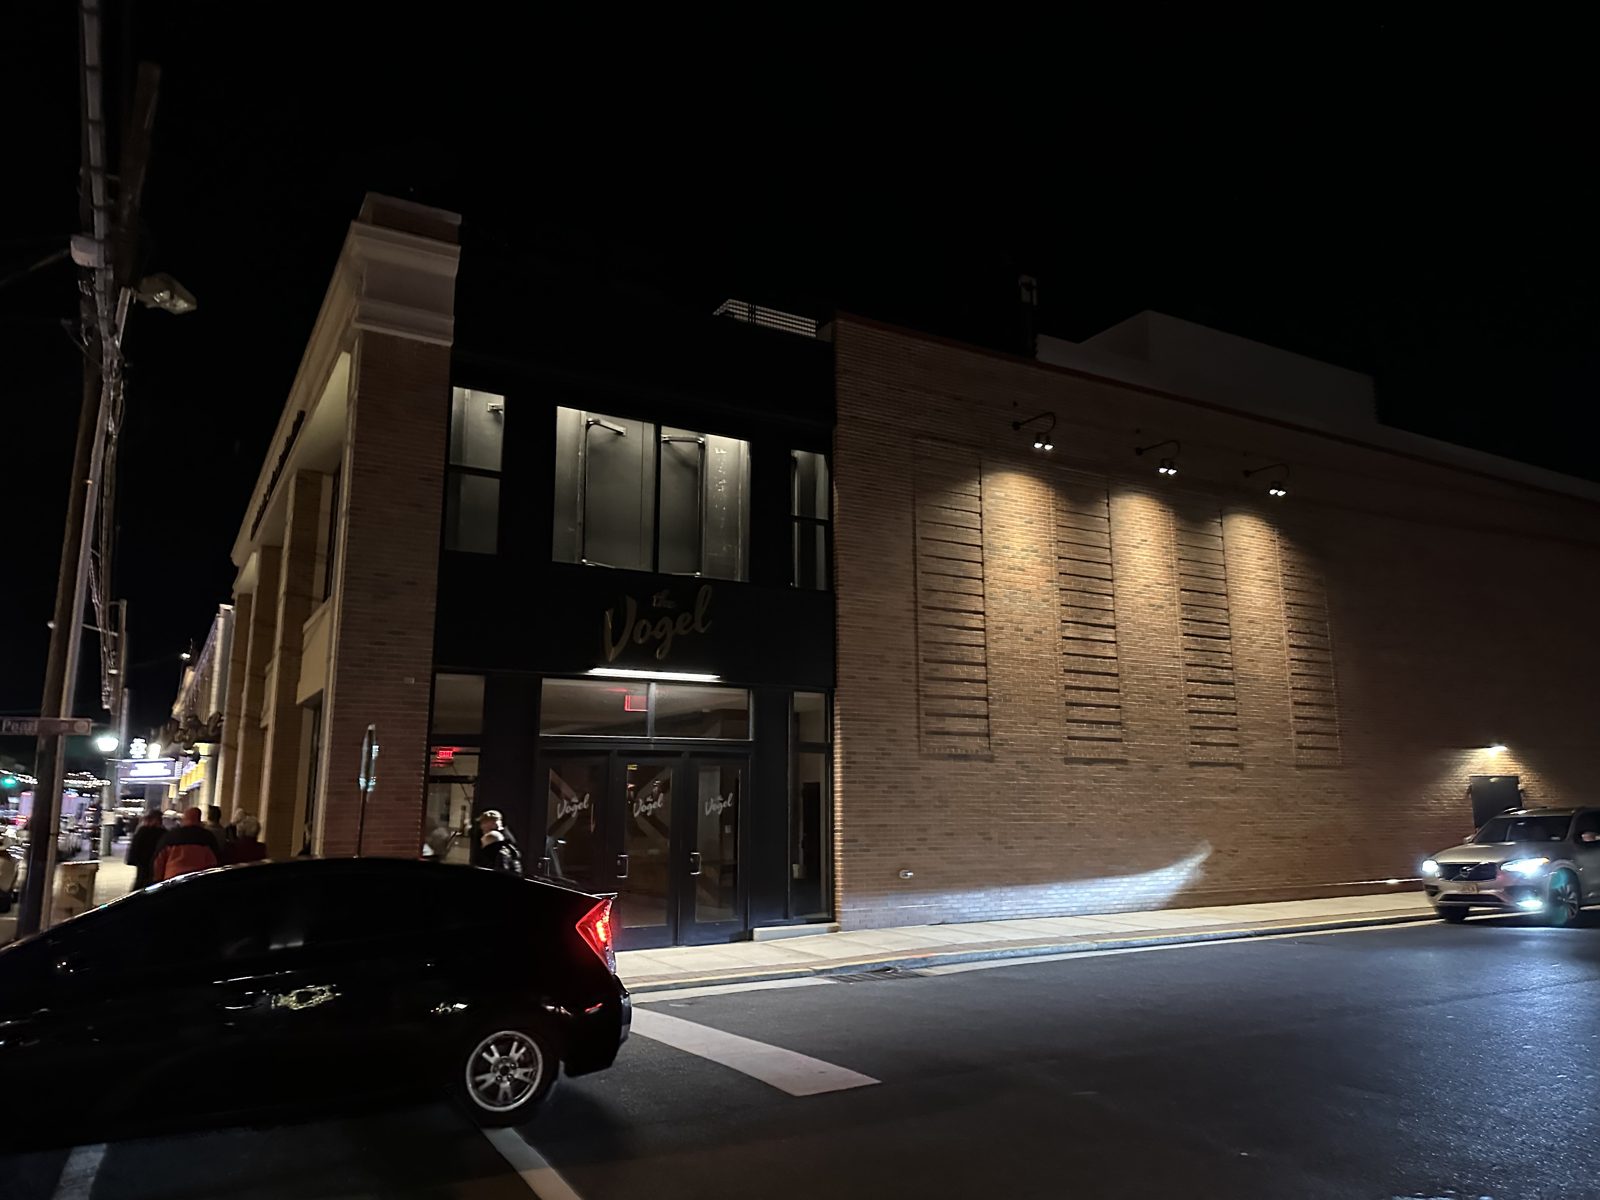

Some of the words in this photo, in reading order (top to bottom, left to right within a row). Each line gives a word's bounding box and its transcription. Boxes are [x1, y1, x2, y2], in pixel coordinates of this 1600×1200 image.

[602, 584, 713, 663] Vogel
[556, 793, 590, 819] Vogel
[633, 792, 664, 818] Vogel
[704, 792, 734, 817] Vogel
